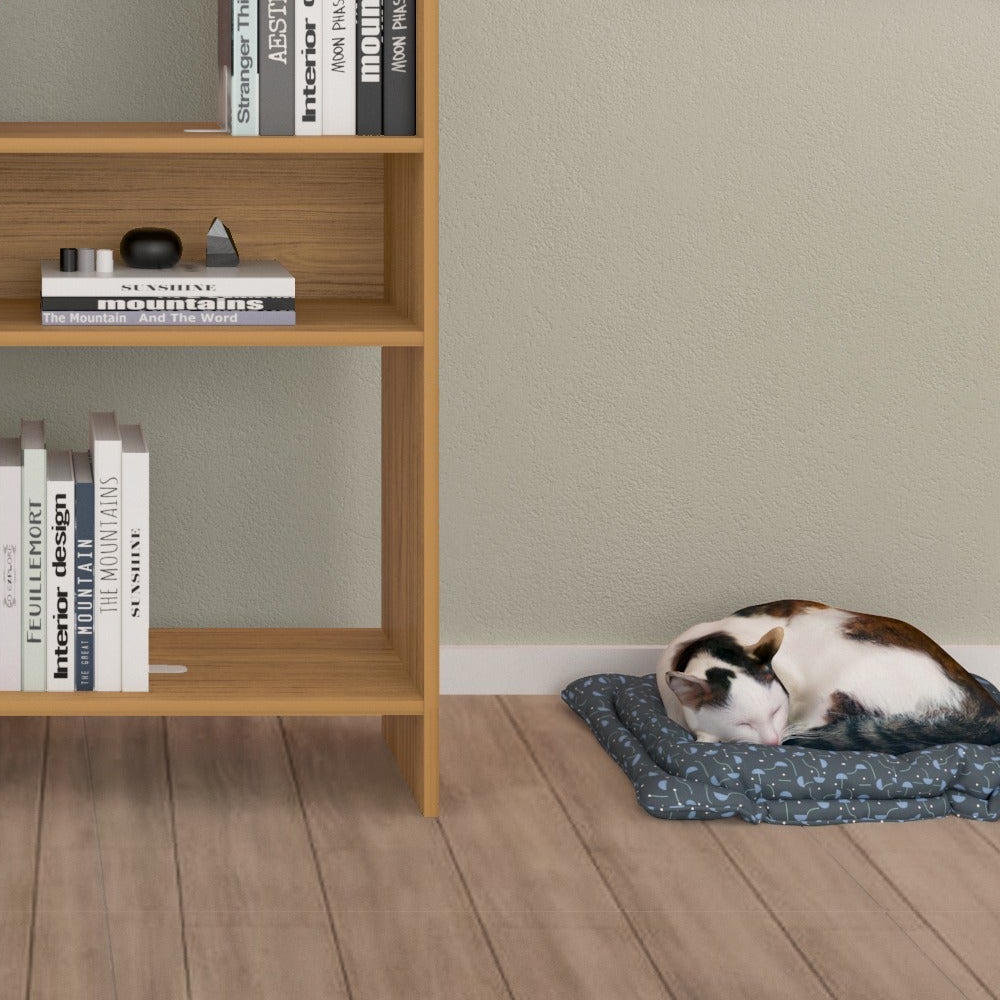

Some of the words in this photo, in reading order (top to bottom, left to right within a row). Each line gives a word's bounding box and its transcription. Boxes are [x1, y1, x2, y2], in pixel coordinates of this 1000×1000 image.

[237, 36, 253, 124] Stranger
[300, 18, 316, 123] Interior
[331, 37, 345, 73] MOON
[391, 36, 407, 73] MOON
[43, 313, 66, 324] The
[69, 313, 127, 324] Mountain
[138, 313, 166, 324] And
[169, 313, 196, 324] The
[200, 313, 239, 324] Word
[97, 296, 265, 311] mountains
[120, 284, 217, 292] SUNSHINE
[51, 493, 71, 578] design
[99, 476, 119, 581] MOUNTAINS
[26, 497, 43, 644] FEUILLEMORT
[77, 539, 93, 636] MOUNTAIN
[99, 588, 118, 614] THE
[130, 528, 142, 618] SUNSHINE
[53, 586, 69, 680] Interior
[81, 640, 89, 666] GREAT
[81, 669, 89, 685] THE
